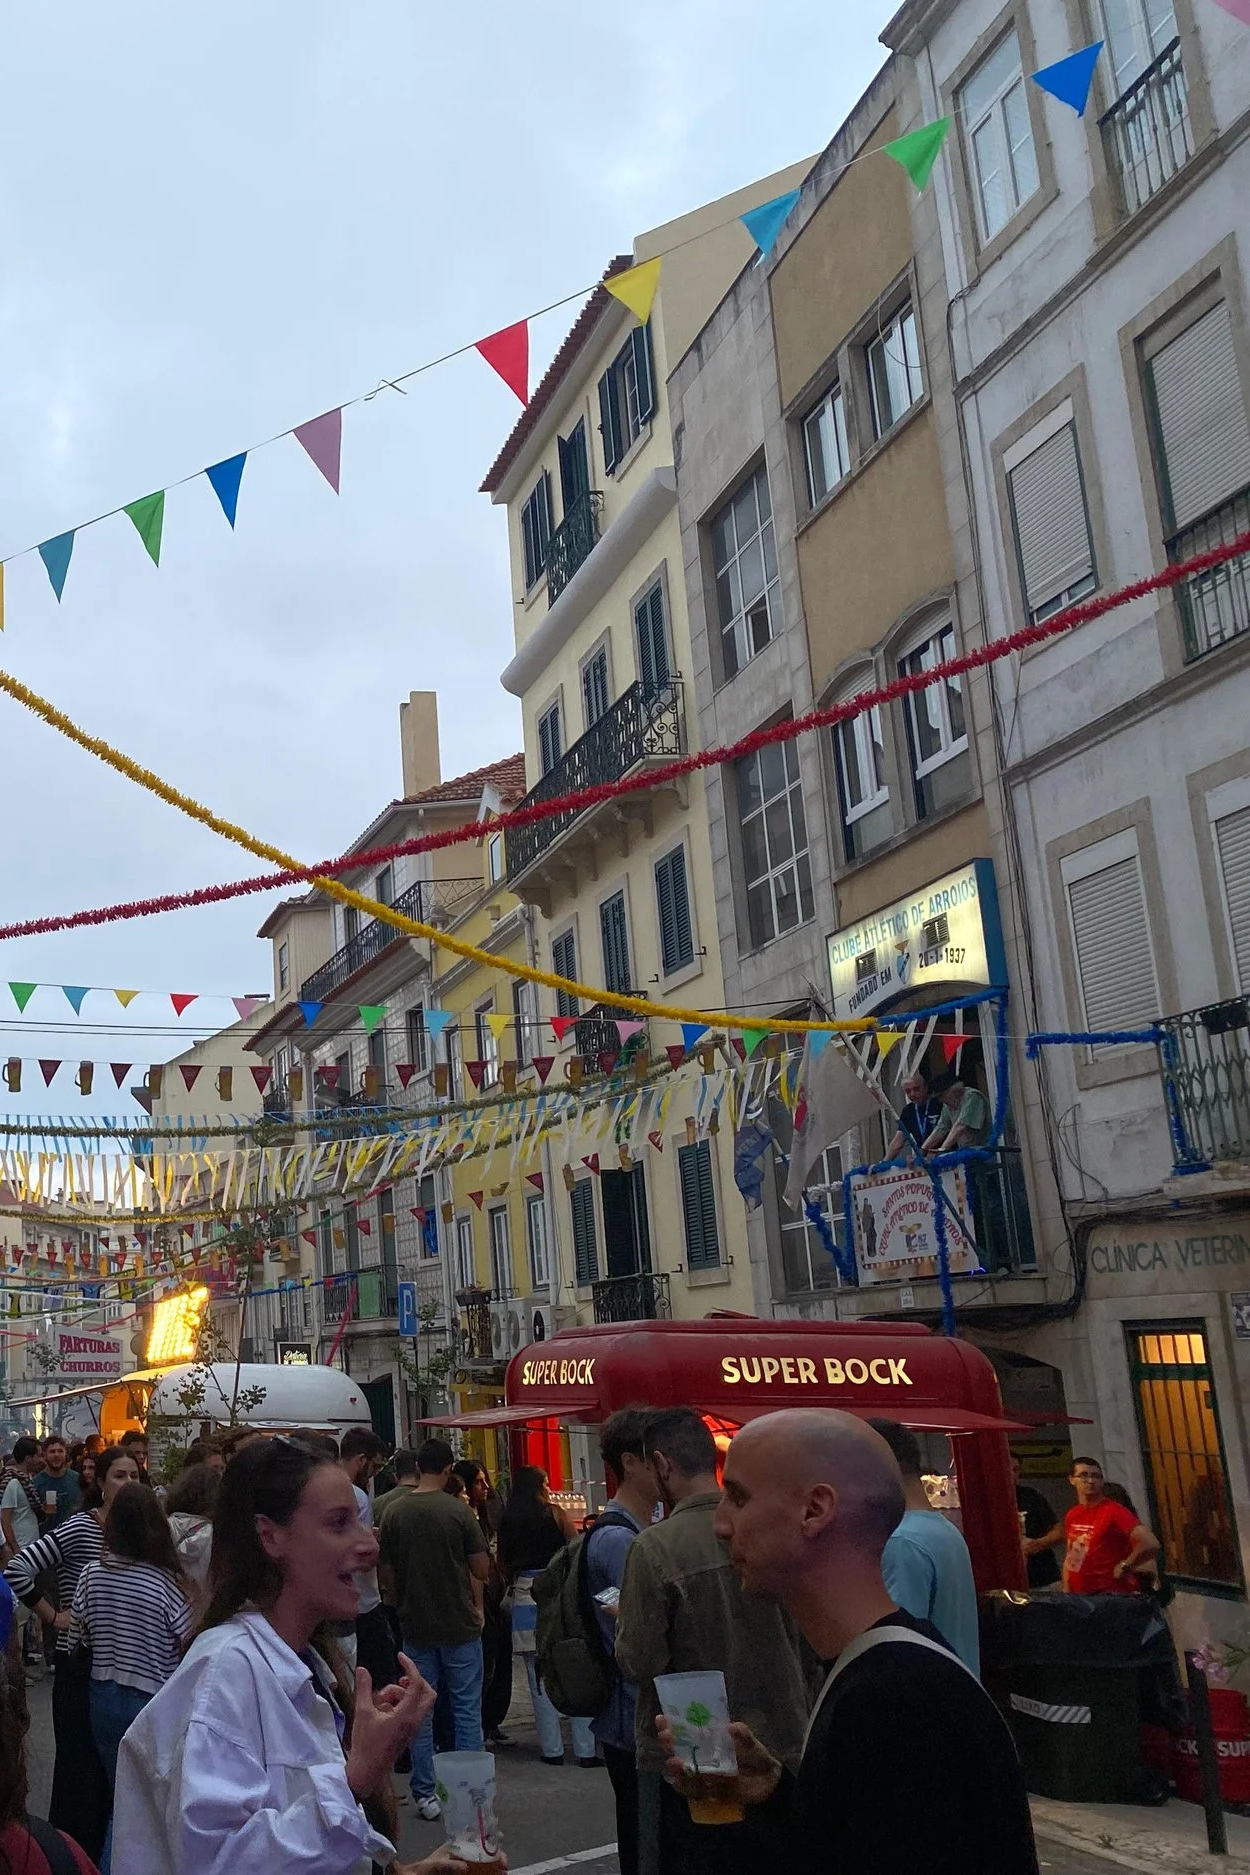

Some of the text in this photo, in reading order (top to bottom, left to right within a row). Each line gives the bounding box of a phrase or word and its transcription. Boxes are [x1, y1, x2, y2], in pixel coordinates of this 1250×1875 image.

[832, 876, 977, 965] CLUBE ATLÉTICO DE ARROIOS
[848, 977, 879, 1014] FUNDADO
[880, 966, 892, 987] EM
[882, 1185, 905, 1218] SANTOS
[919, 1202, 929, 1214] DE
[1091, 1238, 1168, 1274] CLÍNICA
[403, 1289, 413, 1329] P
[59, 1334, 120, 1354] FARTURAS
[60, 1361, 121, 1373] CHURROS
[522, 1357, 596, 1386] SUPER BOCK
[721, 1356, 914, 1386] SUPER BOCK
